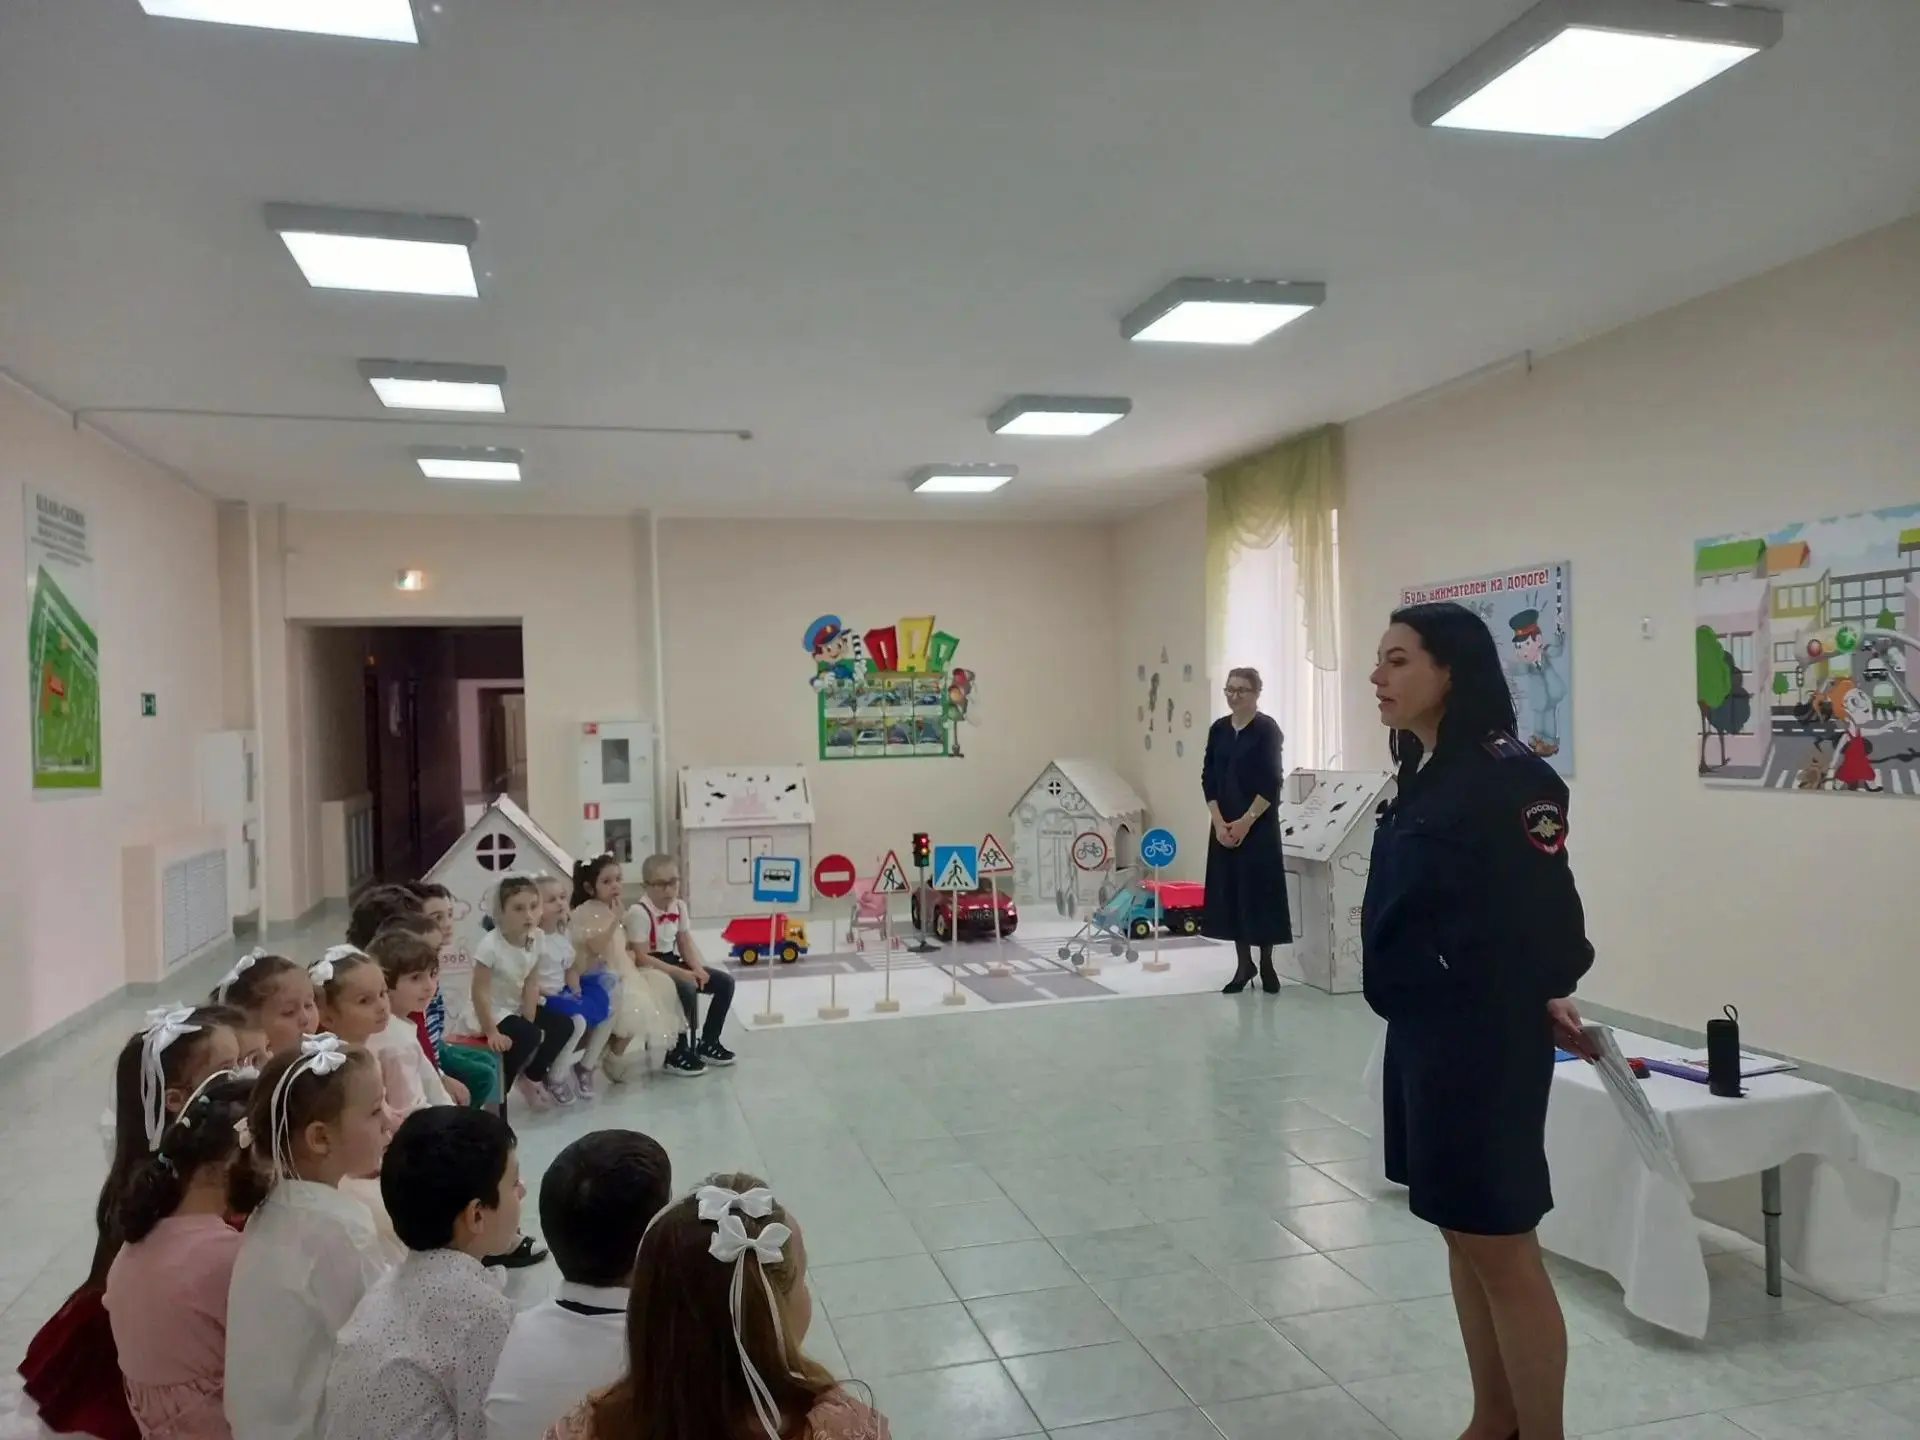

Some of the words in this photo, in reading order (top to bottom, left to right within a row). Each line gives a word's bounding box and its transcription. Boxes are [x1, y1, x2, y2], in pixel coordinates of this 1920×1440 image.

[1404, 591, 1426, 605] Будь
[1430, 581, 1487, 601] внимателен
[1491, 579, 1503, 592] на
[1507, 569, 1549, 590] дороге!
[1526, 804, 1559, 819] РОССИЯ
